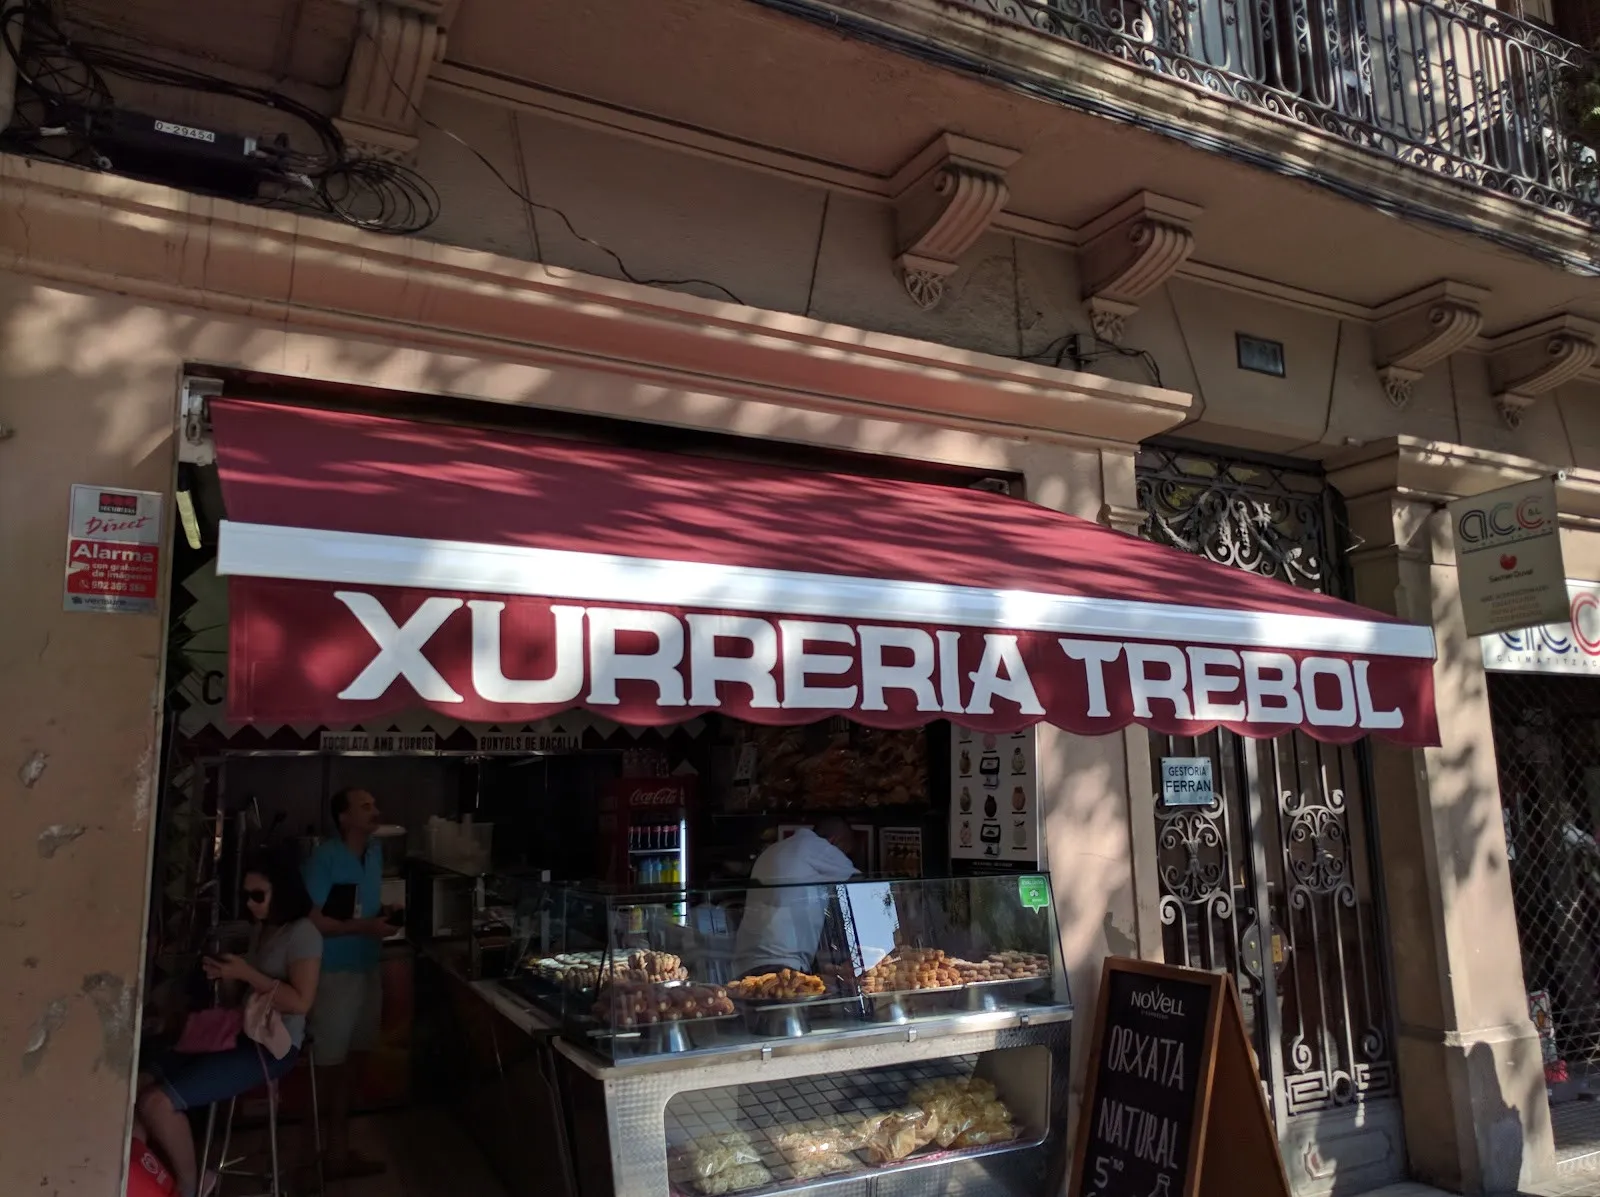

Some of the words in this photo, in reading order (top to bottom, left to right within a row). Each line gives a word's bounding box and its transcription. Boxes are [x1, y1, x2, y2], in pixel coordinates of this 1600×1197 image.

[86, 516, 152, 535] Direct
[73, 543, 155, 563] Alarma
[333, 591, 1047, 716] XURRERIA
[1058, 637, 1405, 729] TREBOL
[373, 736, 394, 750] AMB
[480, 736, 521, 750] BUNYOLS
[525, 736, 536, 750] DE
[1165, 780, 1212, 793] FERRAN
[1107, 1025, 1185, 1092] ORXATA
[1097, 1097, 1179, 1170] NATURAL
